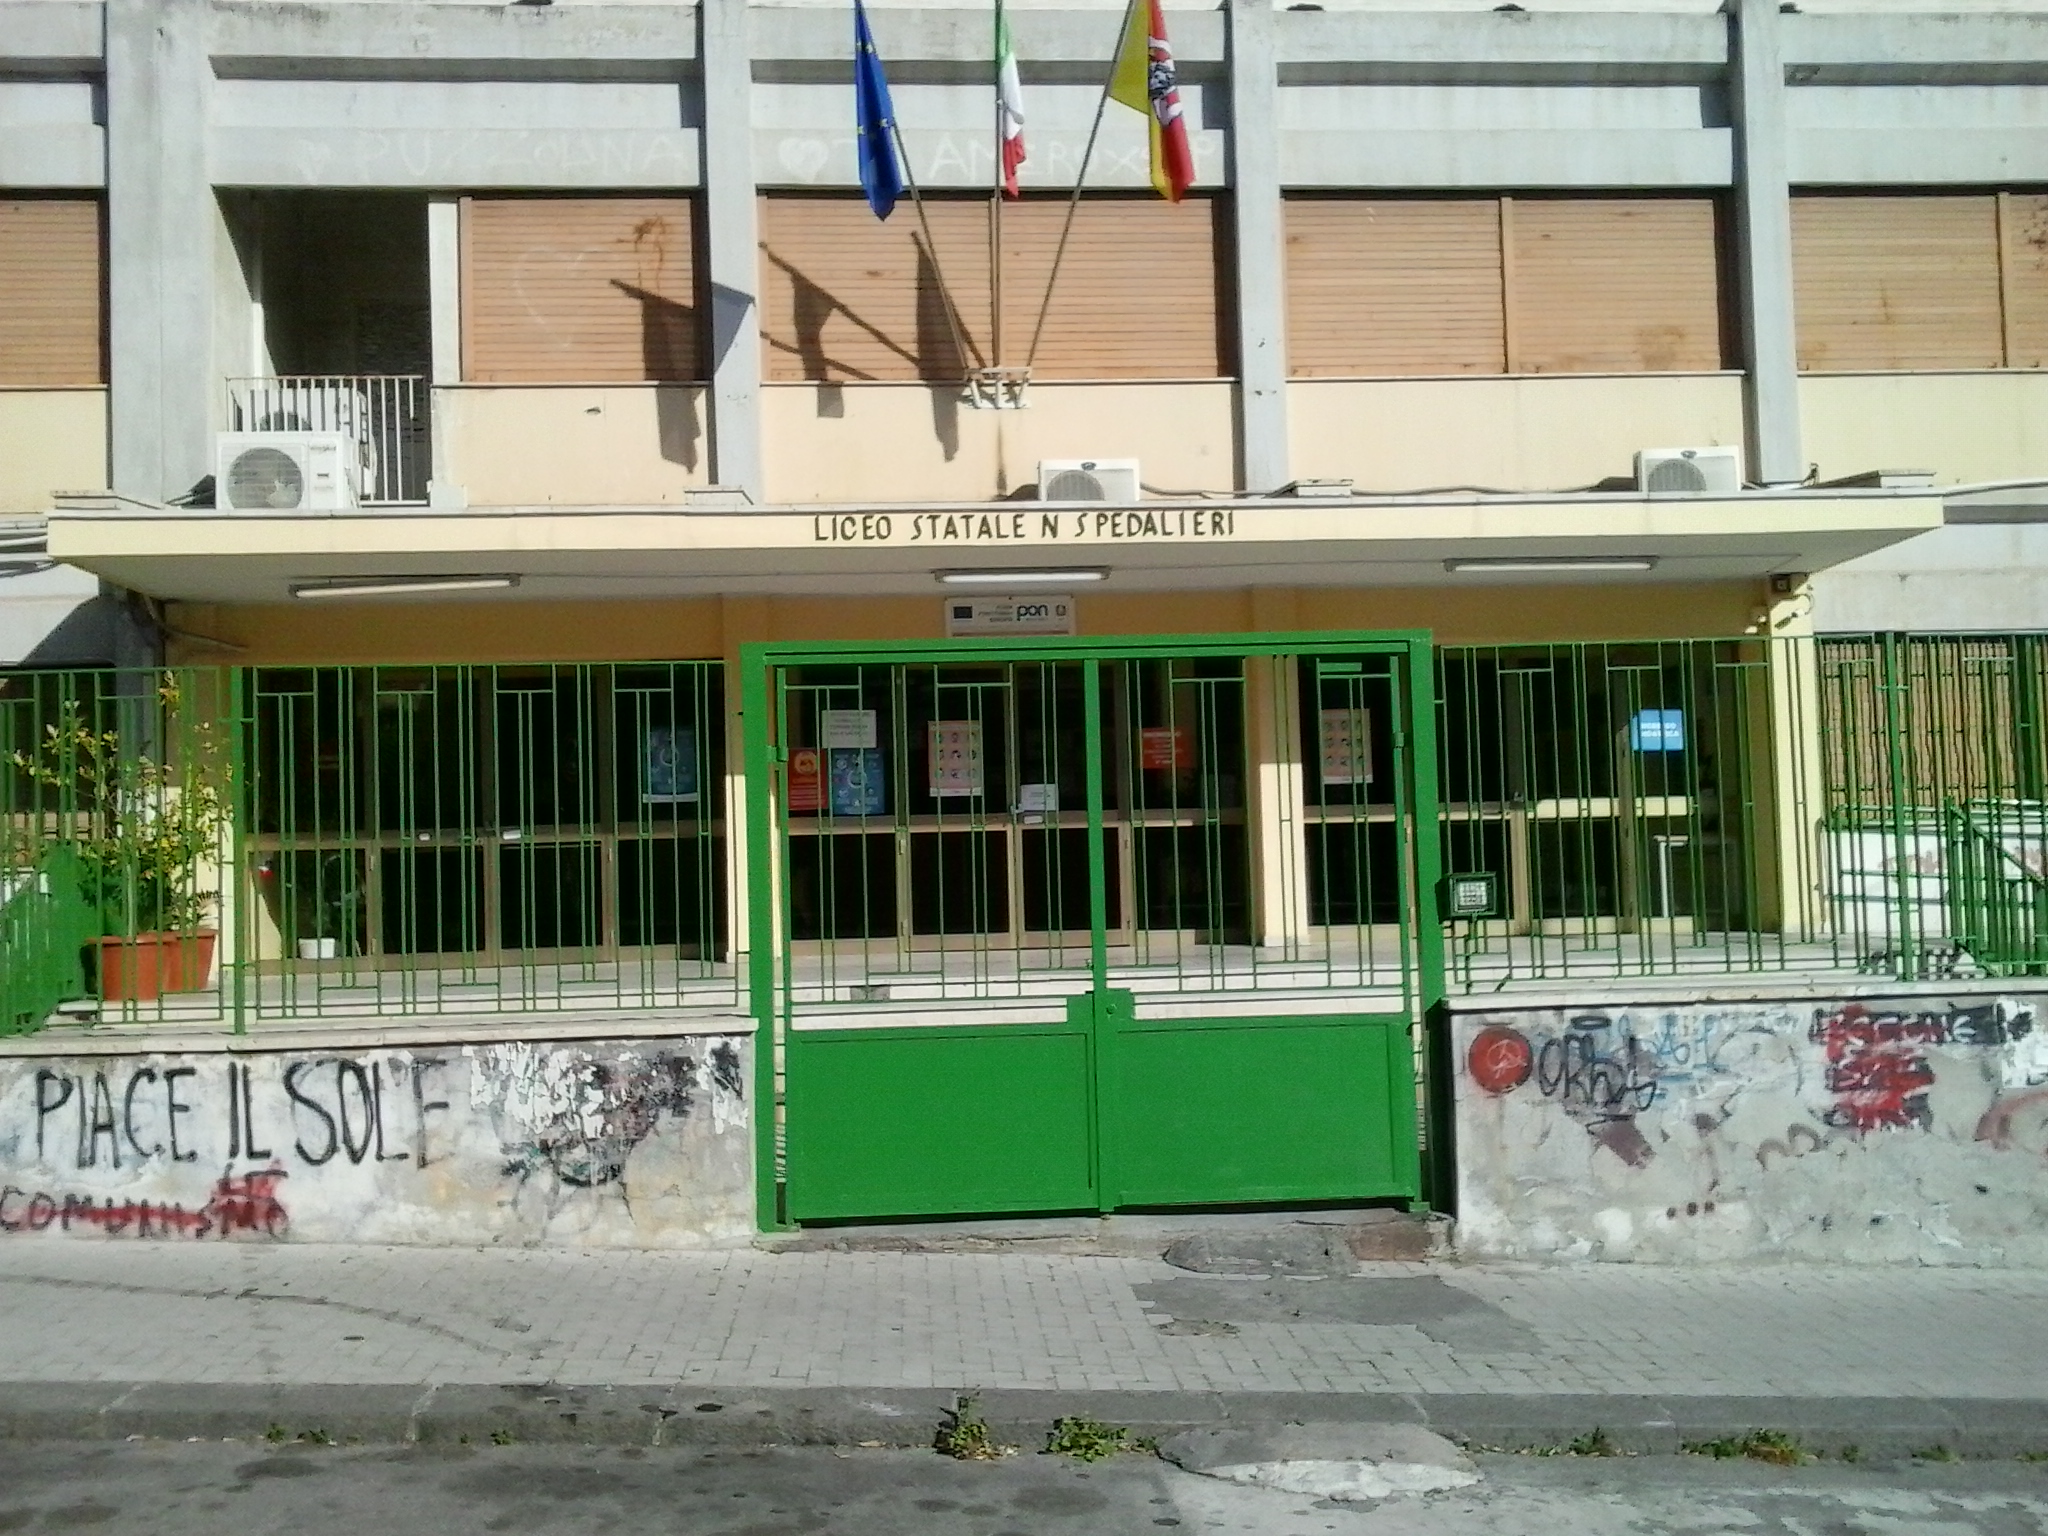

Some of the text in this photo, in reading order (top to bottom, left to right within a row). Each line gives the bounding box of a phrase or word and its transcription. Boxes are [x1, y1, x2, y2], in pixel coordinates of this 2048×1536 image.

[813, 509, 1235, 542] LICEO STATALE N SPEDALIERI
[1017, 604, 1048, 622] pon
[34, 1066, 199, 1169] PIACE
[228, 1061, 273, 1160] IL
